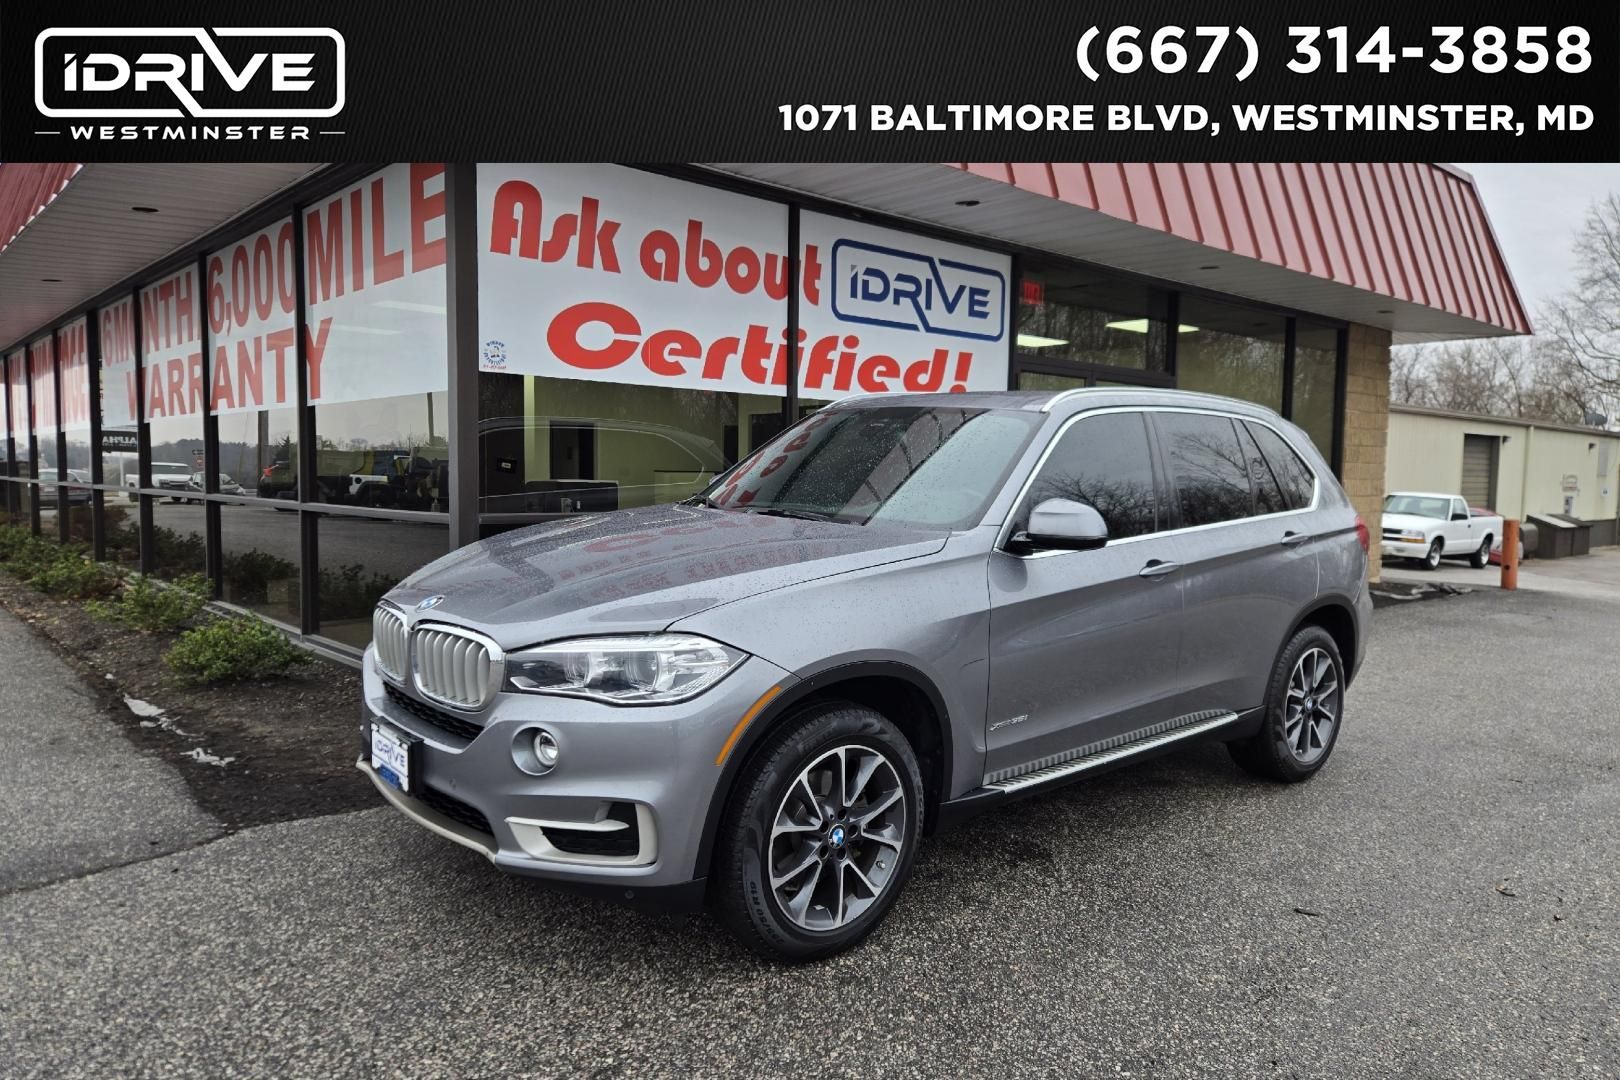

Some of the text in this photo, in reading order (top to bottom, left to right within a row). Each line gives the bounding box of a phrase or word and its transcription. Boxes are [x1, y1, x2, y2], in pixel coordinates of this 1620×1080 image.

[207, 222, 296, 336] 6,000
[307, 163, 446, 306] MILE
[490, 180, 621, 274] Ask
[639, 219, 822, 306] about
[126, 317, 334, 421] WARRANTY
[547, 301, 974, 394] Certified!
